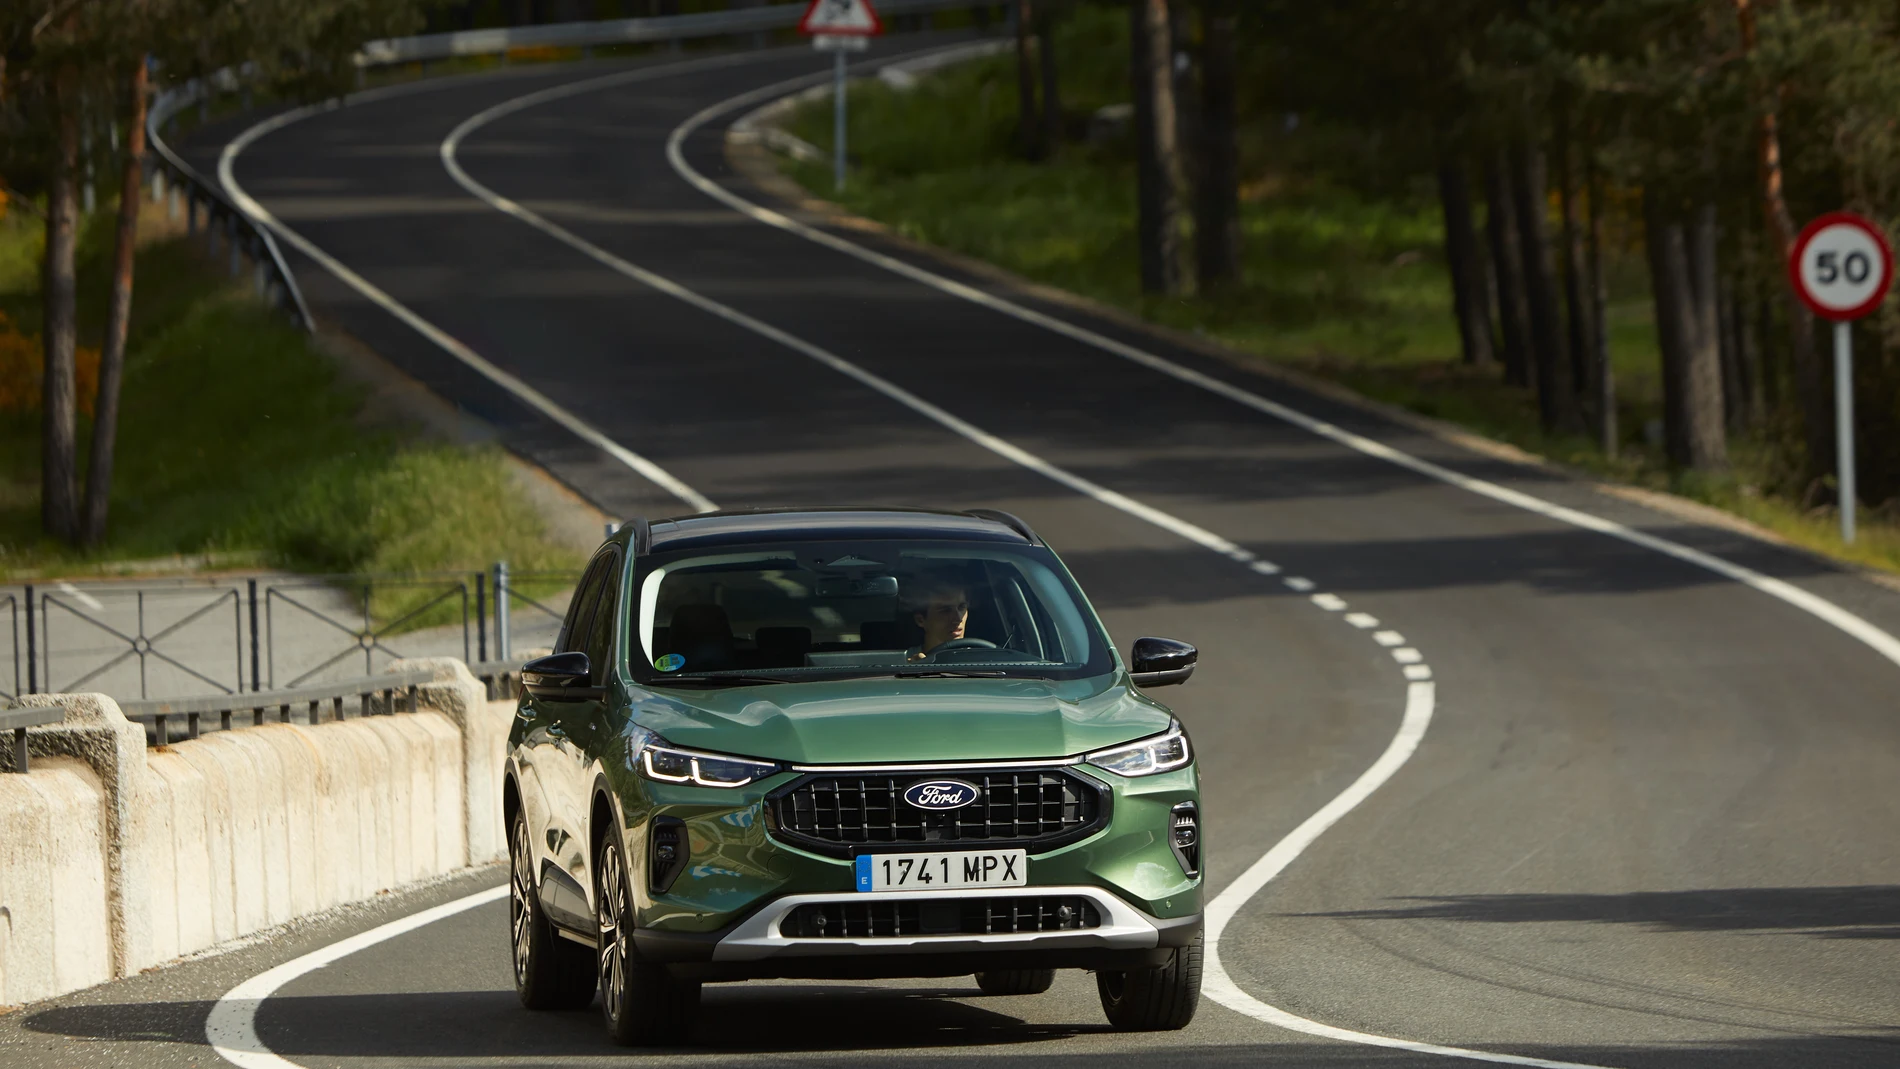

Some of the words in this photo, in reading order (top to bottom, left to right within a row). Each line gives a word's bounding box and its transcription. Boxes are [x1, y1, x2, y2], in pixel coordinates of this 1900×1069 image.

[1816, 250, 1871, 285] 50
[918, 785, 963, 805] Ford
[861, 877, 868, 885] E
[882, 858, 949, 886] 1741
[963, 854, 1018, 883] MPX
